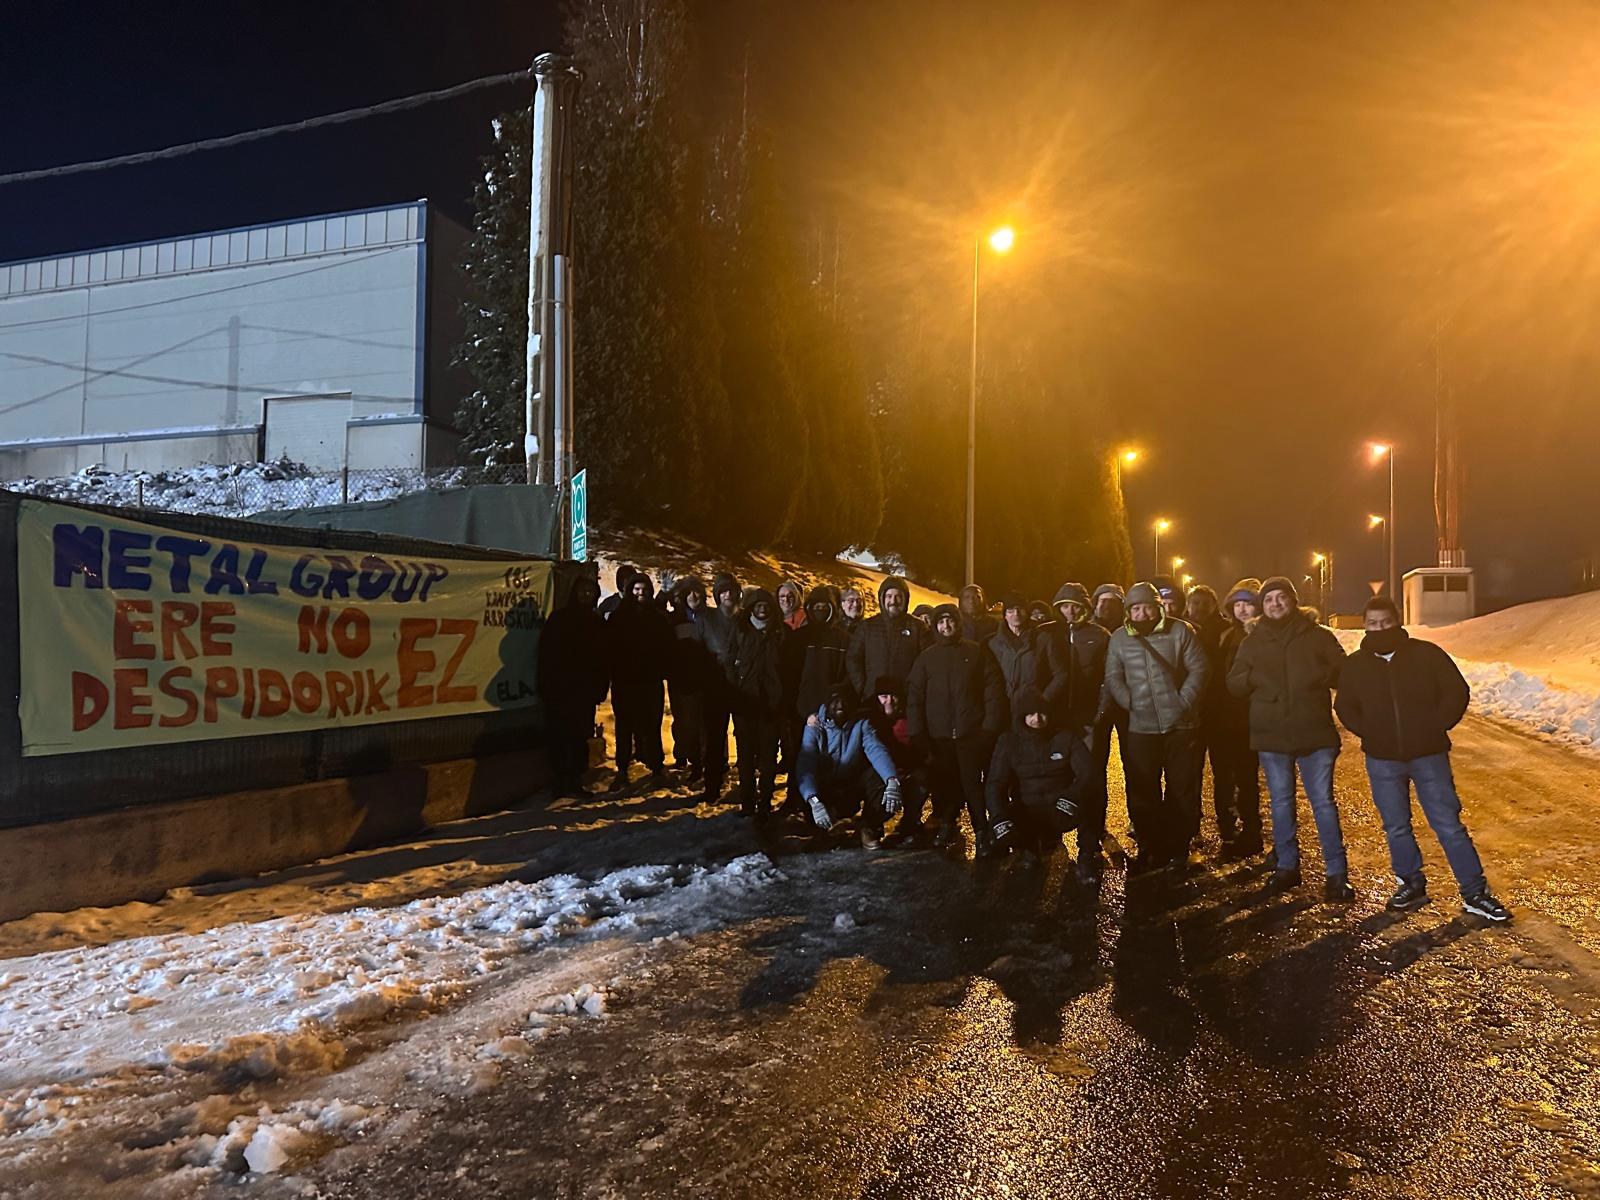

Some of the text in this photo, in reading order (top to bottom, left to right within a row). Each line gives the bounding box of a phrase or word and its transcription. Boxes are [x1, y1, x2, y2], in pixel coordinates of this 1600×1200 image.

[53, 523, 449, 603] METAL GROUP
[113, 599, 371, 661] ERE NO
[72, 617, 479, 732] DESPIDORIK EZ
